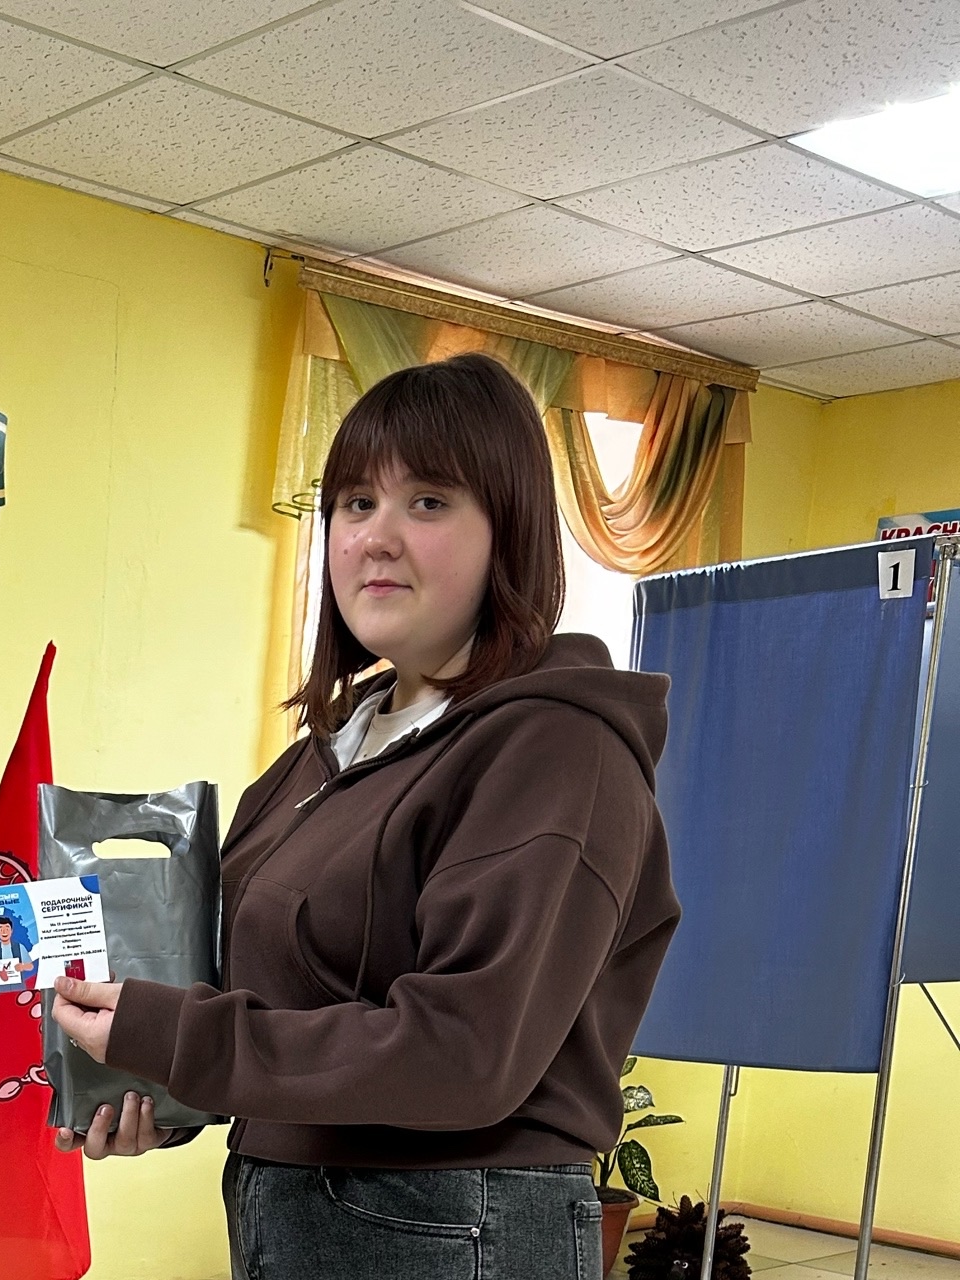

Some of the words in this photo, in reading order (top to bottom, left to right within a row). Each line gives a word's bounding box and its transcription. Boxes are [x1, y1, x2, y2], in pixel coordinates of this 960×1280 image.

[881, 521, 960, 541] КРАСН
[887, 562, 901, 591] 1
[41, 894, 93, 906] ПОДАРОЧНЫЙ
[41, 902, 93, 913] СЕРТИФИКАТ
